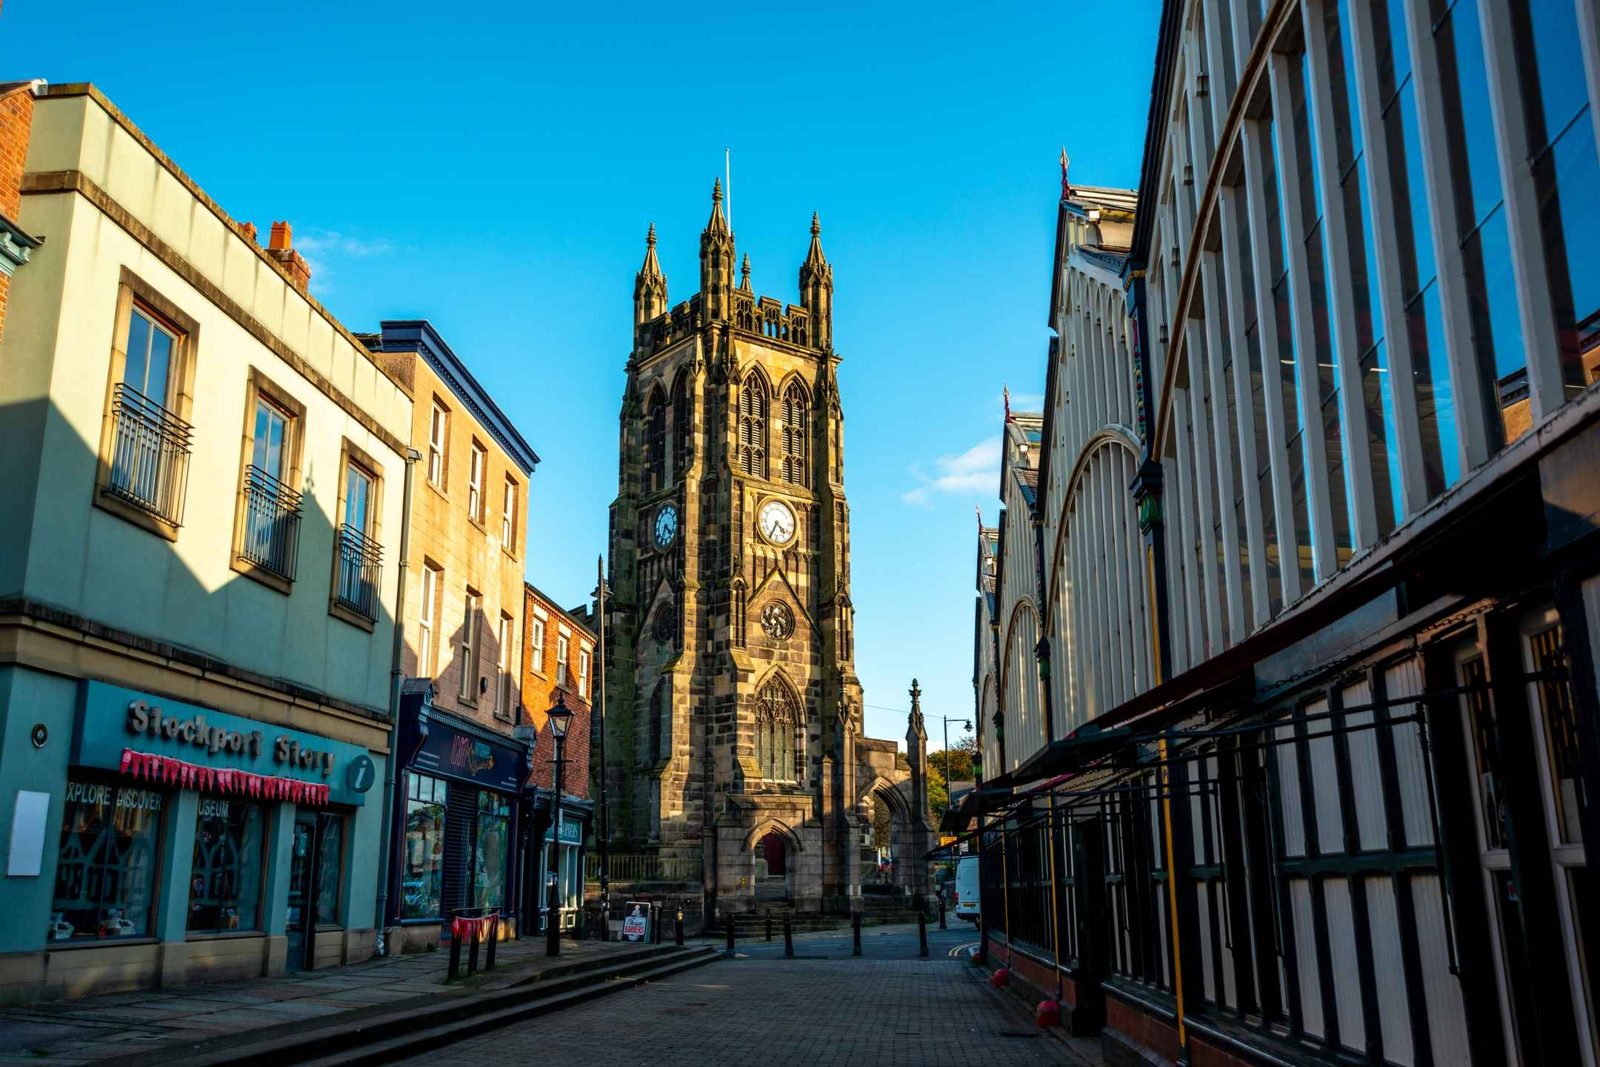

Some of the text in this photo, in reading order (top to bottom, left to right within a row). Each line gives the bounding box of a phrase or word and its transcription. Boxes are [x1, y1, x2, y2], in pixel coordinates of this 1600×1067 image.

[128, 699, 335, 775] Stockport Story
[66, 783, 162, 811] XPLORE DISCOVER
[198, 799, 230, 818] USEUM
